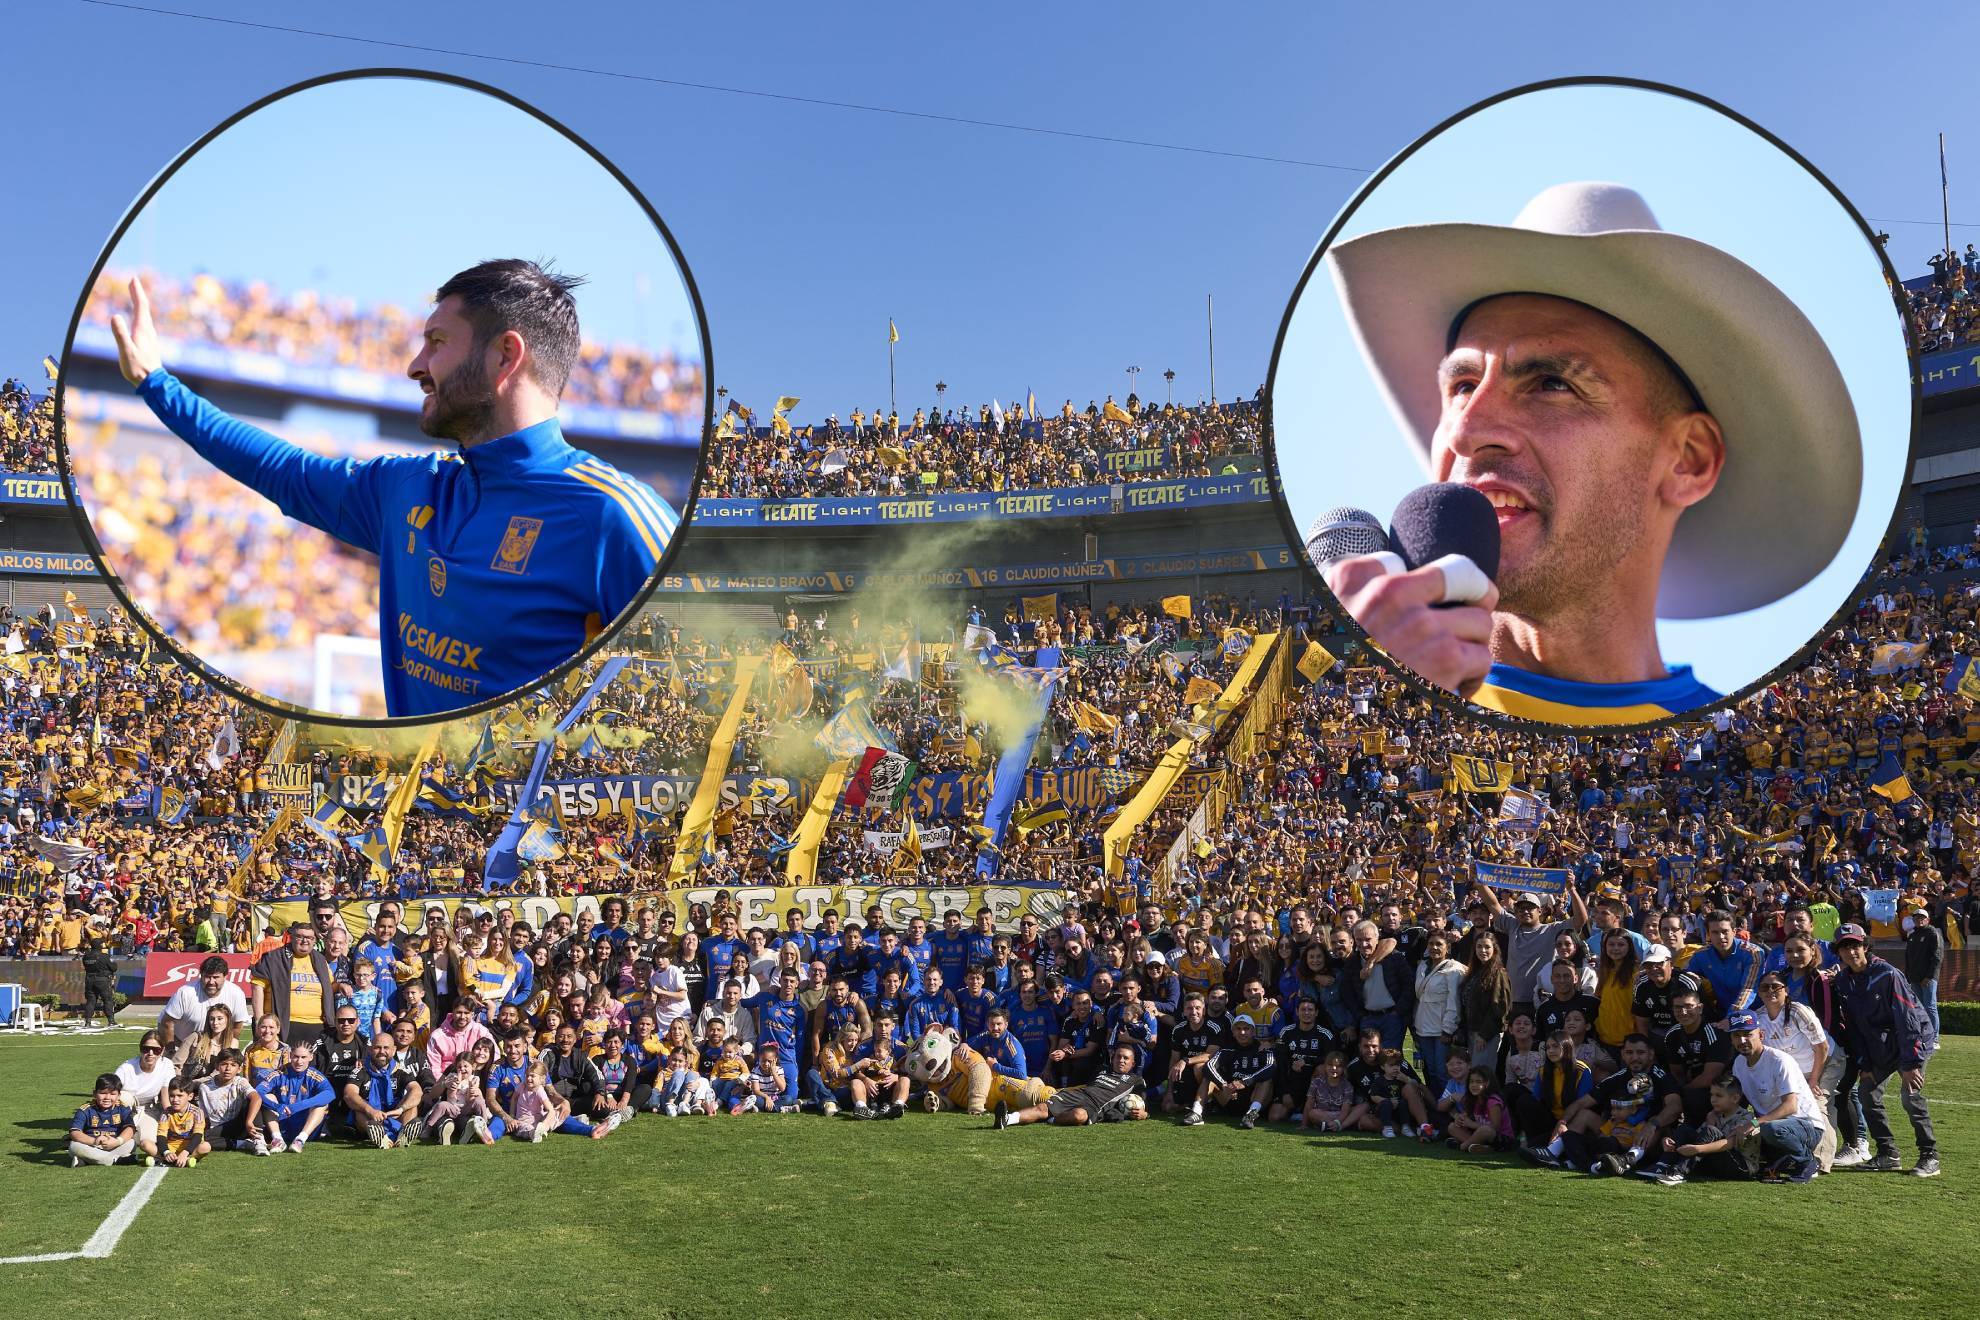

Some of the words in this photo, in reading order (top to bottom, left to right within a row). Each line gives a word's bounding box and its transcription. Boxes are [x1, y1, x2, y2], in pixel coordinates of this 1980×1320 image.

[1104, 448, 1164, 471] TECATE
[703, 508, 755, 517] LIGHT
[760, 503, 820, 521] TECATE
[822, 507, 873, 516] LIGHT
[877, 500, 936, 519] TECATE
[938, 502, 990, 513] LIGHT
[995, 494, 1055, 514] TECATE
[1057, 496, 1109, 507] LIGHT
[1126, 484, 1188, 507] TECATE
[1189, 484, 1244, 496] LIGHT
[0, 556, 44, 569] RLOS
[1279, 551, 1289, 564] 5
[981, 570, 998, 582] 16
[1006, 566, 1060, 581] CLAUDIO
[1143, 559, 1196, 574] CLAUDIO
[704, 577, 720, 588] 12
[727, 576, 776, 588] MATEO
[779, 576, 826, 588] BRAVO
[845, 575, 855, 587] 6
[405, 623, 482, 671] CEMEX
[1466, 758, 1500, 788] U
[488, 782, 600, 818] LIES
[604, 780, 625, 815] Y
[632, 780, 741, 815] LOKS
[919, 828, 951, 844] PRESENTE
[1482, 874, 1498, 883] NOS
[1530, 879, 1561, 890] GORDO
[796, 886, 1068, 934] TIGRES
[151, 962, 251, 987] SPTI
